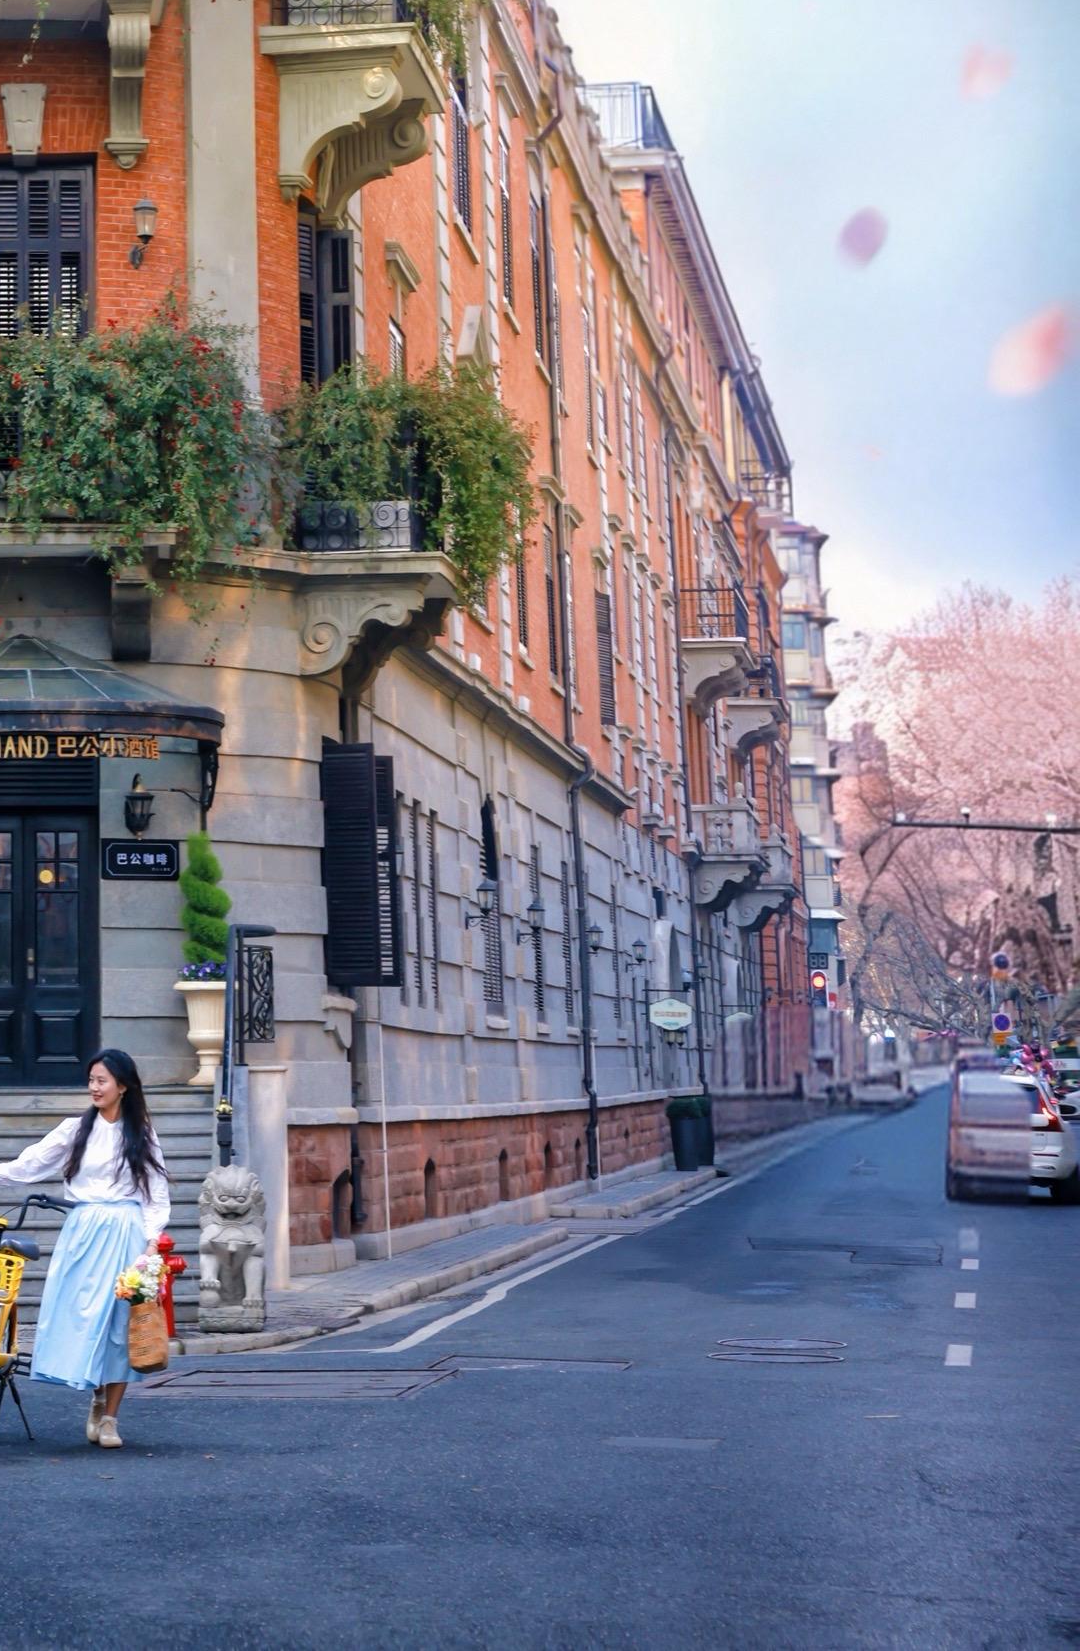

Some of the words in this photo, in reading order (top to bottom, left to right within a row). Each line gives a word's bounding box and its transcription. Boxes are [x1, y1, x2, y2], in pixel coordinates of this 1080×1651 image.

[56, 735, 160, 760] 巴公小酒馆
[116, 853, 168, 865] 巴公咖啡
